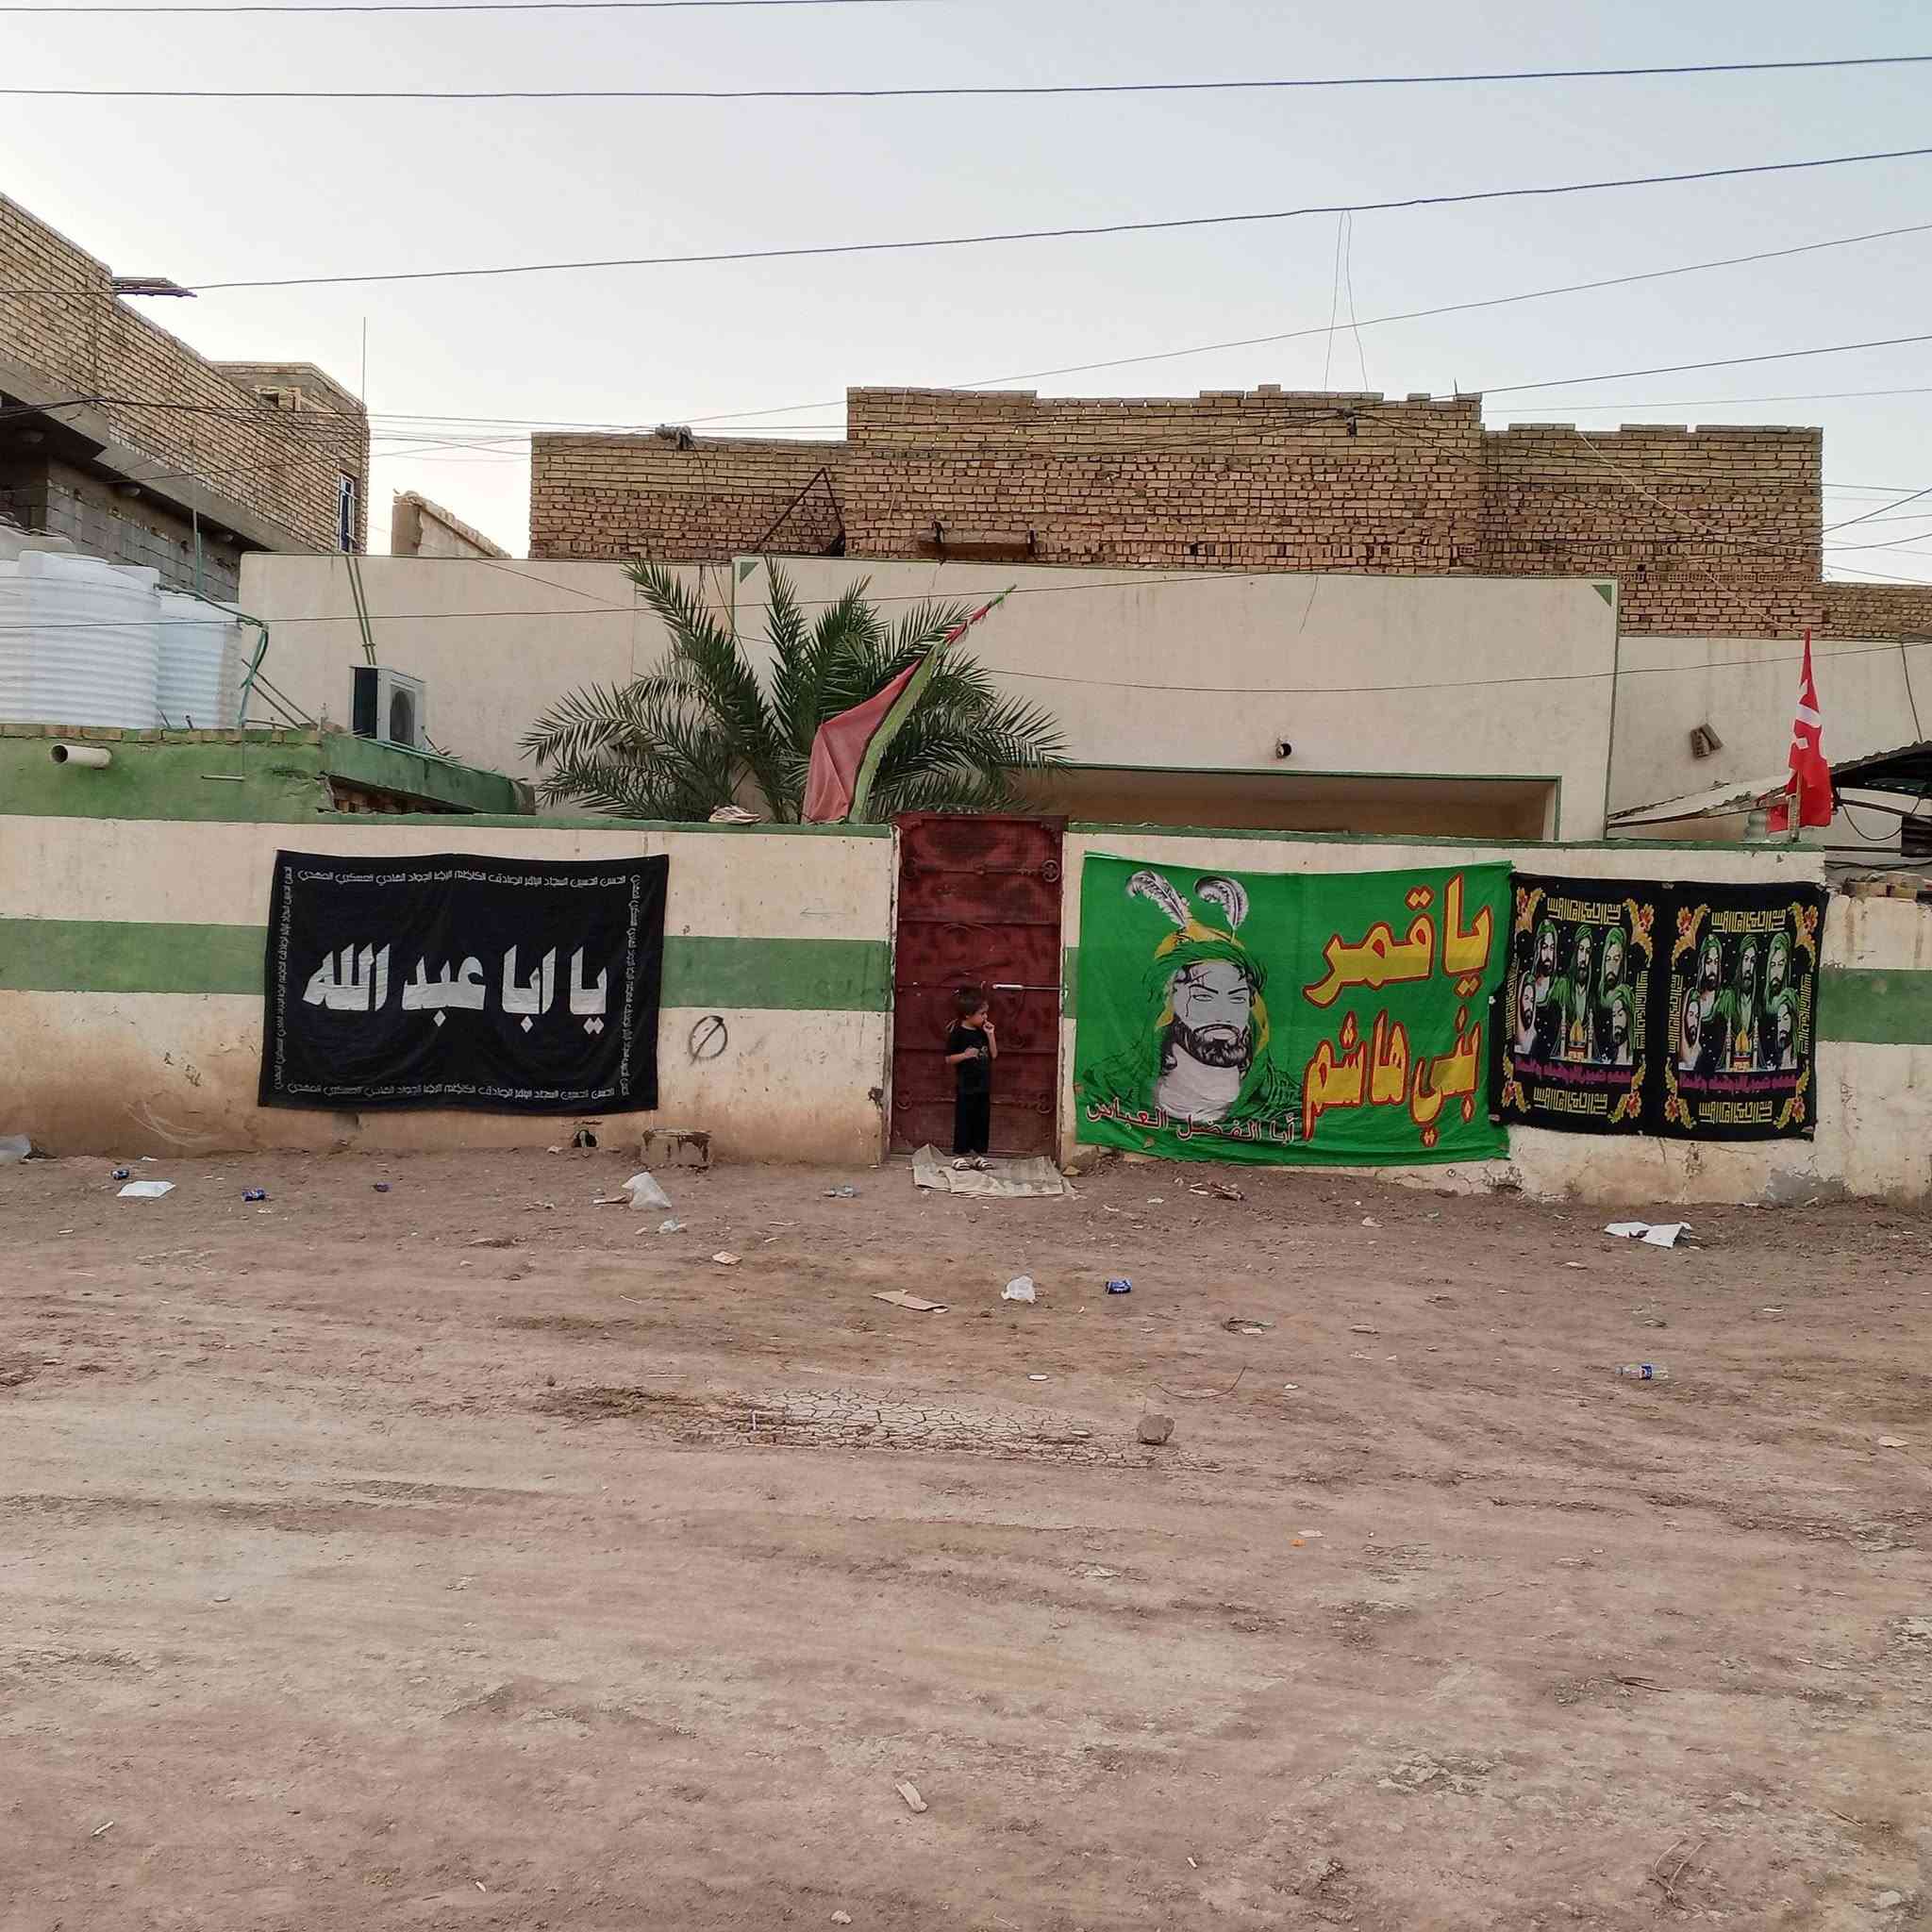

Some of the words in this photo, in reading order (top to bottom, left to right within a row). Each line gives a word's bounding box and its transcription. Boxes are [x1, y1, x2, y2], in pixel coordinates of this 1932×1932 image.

[301, 941, 391, 1012] الله
[1303, 885, 1436, 1009] قمر
[1442, 872, 1494, 999] يا
[401, 956, 487, 1027] عبد
[502, 943, 558, 1034] ابا
[569, 946, 608, 1035] يا
[1086, 1096, 1170, 1132] العباس
[1303, 1009, 1409, 1141] هاشم
[1408, 1004, 1482, 1147] بني
[1176, 1114, 1261, 1142] الفضل
